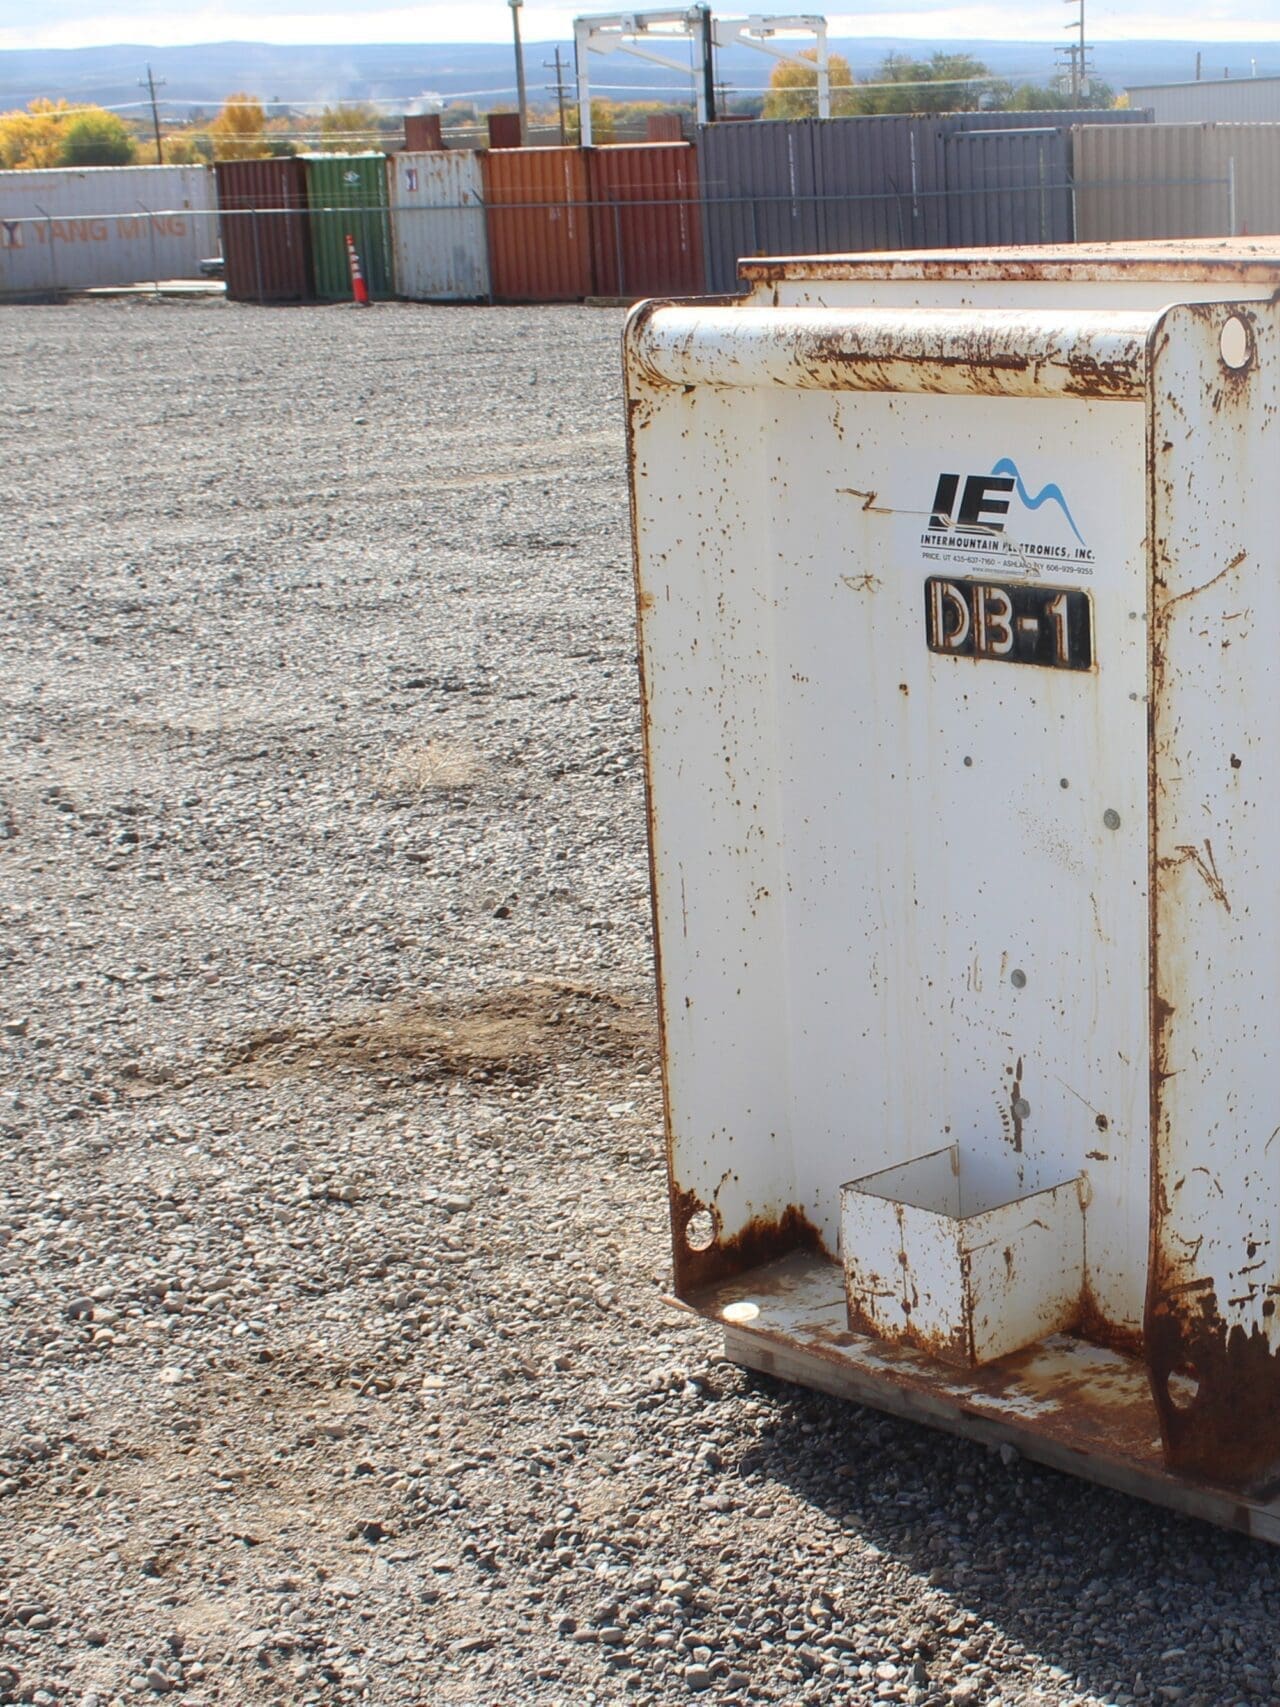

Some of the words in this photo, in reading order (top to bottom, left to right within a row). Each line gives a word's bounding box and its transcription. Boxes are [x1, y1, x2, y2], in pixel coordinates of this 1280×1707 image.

[32, 219, 108, 244] YANG
[117, 216, 187, 240] MING
[920, 535, 999, 551] INTERMOUNTAIN
[1003, 542, 1070, 558] LTRONICS,
[1075, 548, 1096, 560] INC.
[930, 580, 1070, 663] DB-1
